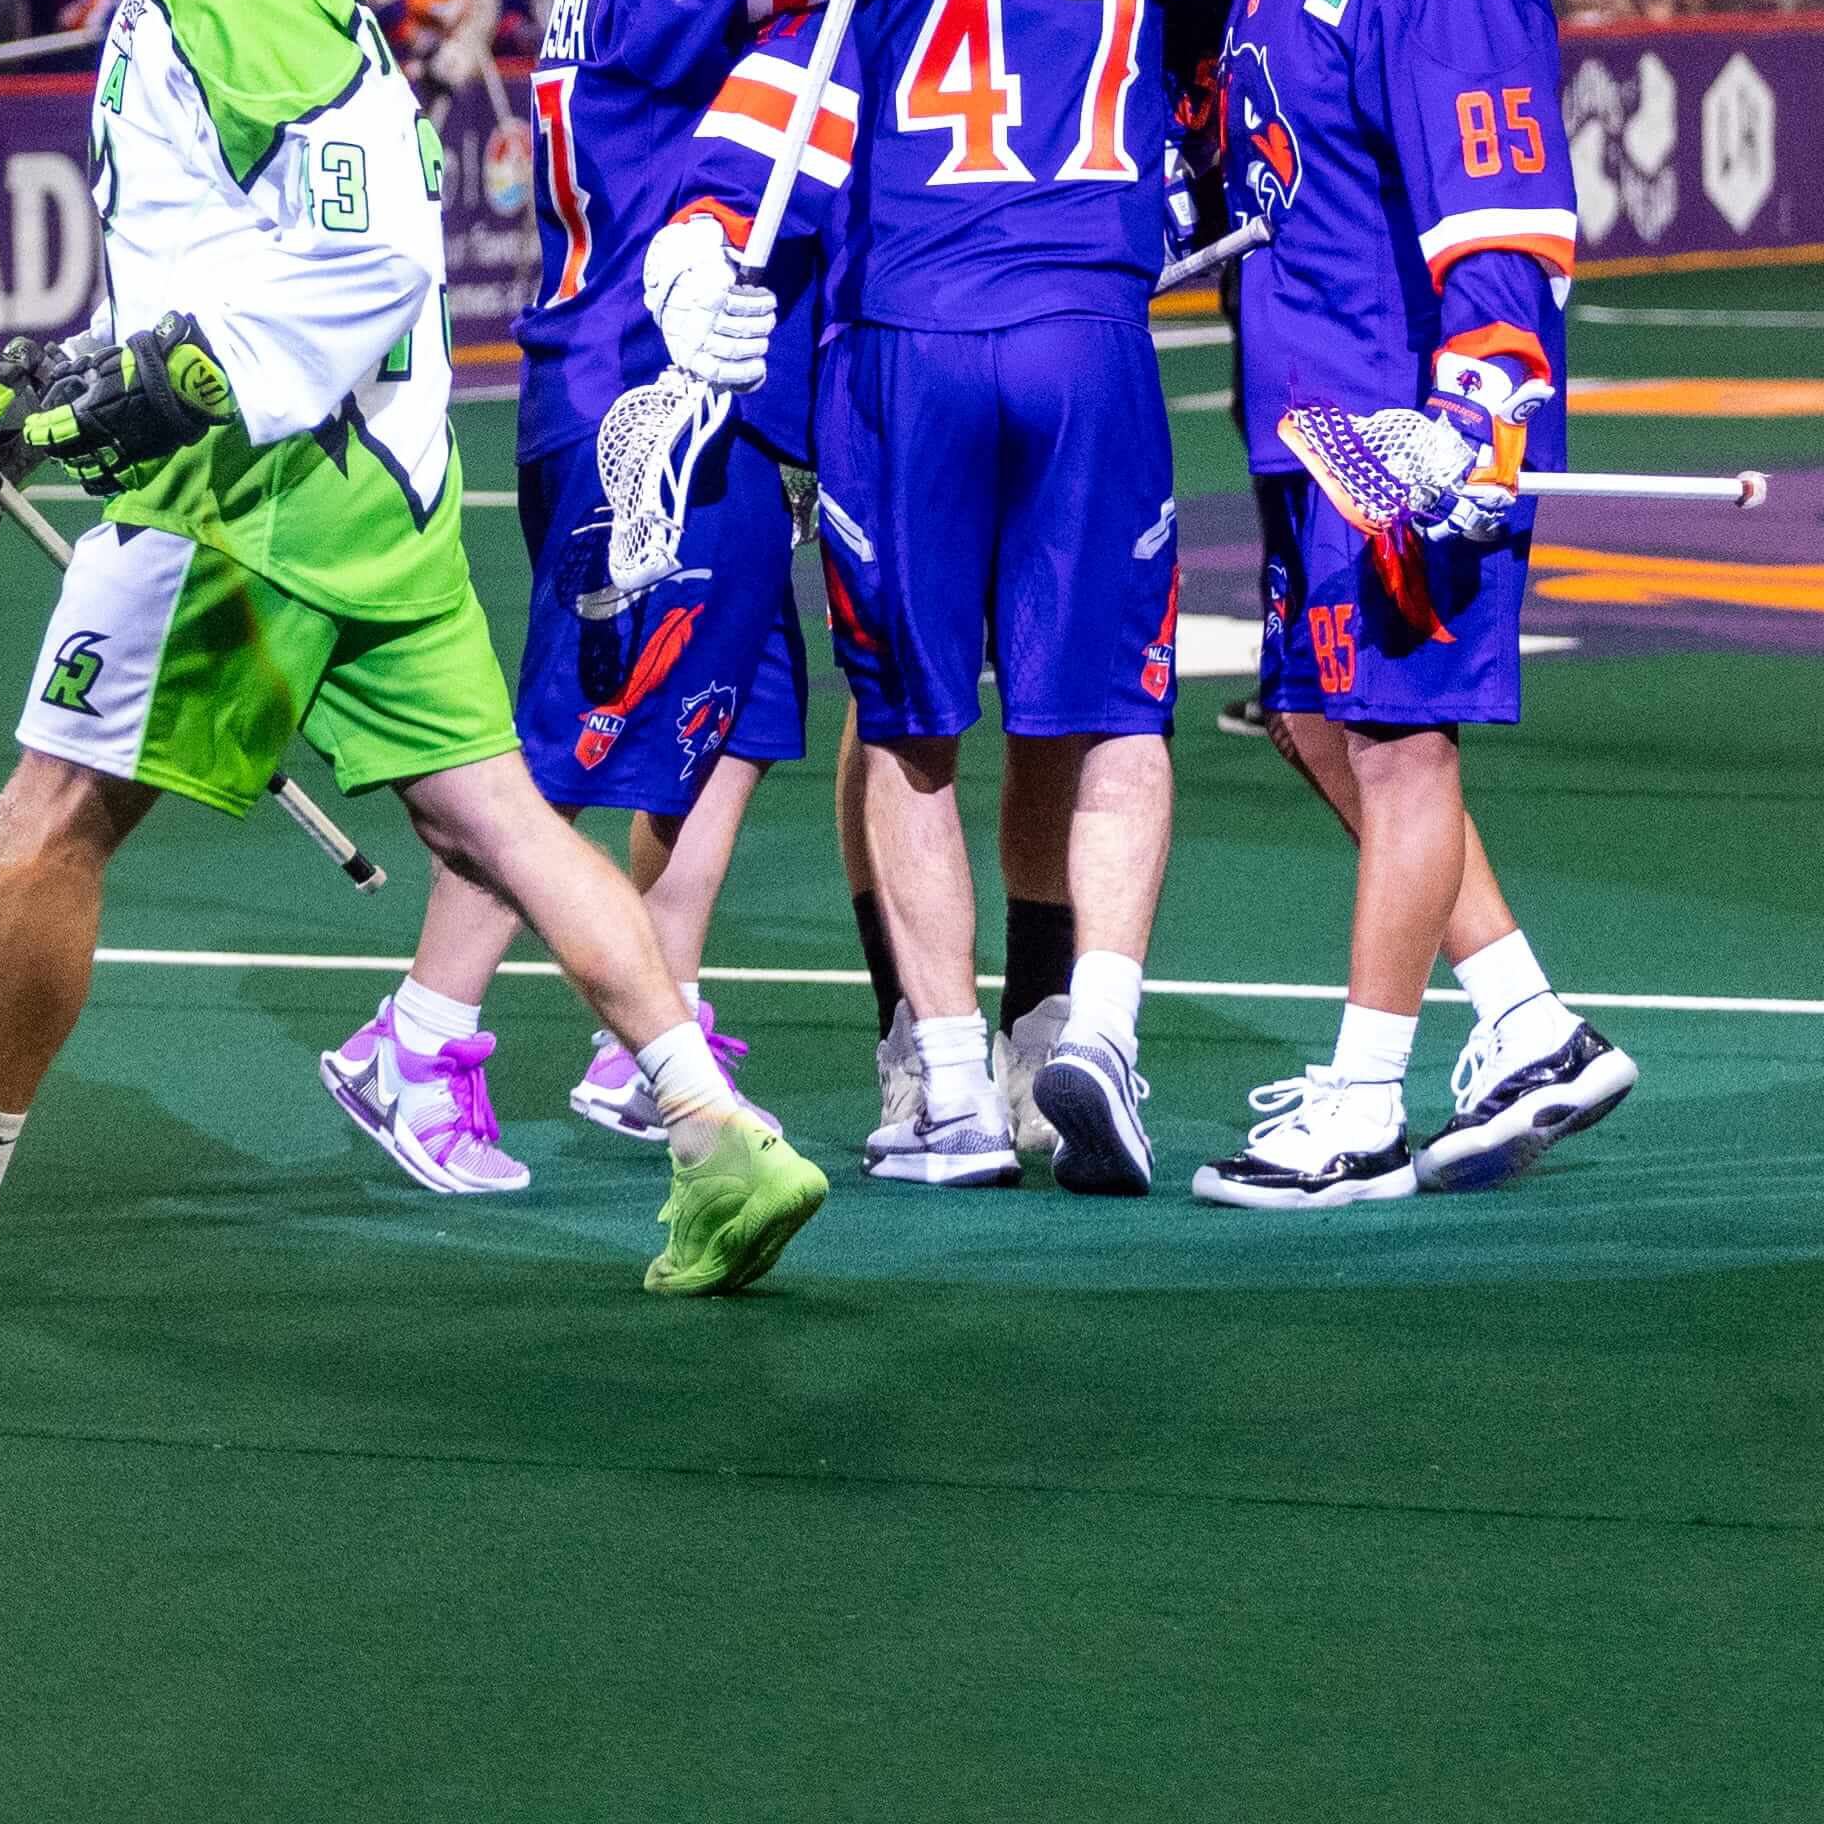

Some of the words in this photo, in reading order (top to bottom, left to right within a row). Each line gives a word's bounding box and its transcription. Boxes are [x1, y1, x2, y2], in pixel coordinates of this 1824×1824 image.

[100, 53, 129, 115] A
[1456, 87, 1546, 178] 85
[1148, 647, 1170, 662] NLL
[1308, 603, 1355, 694] 85
[588, 715, 618, 733] NLL
